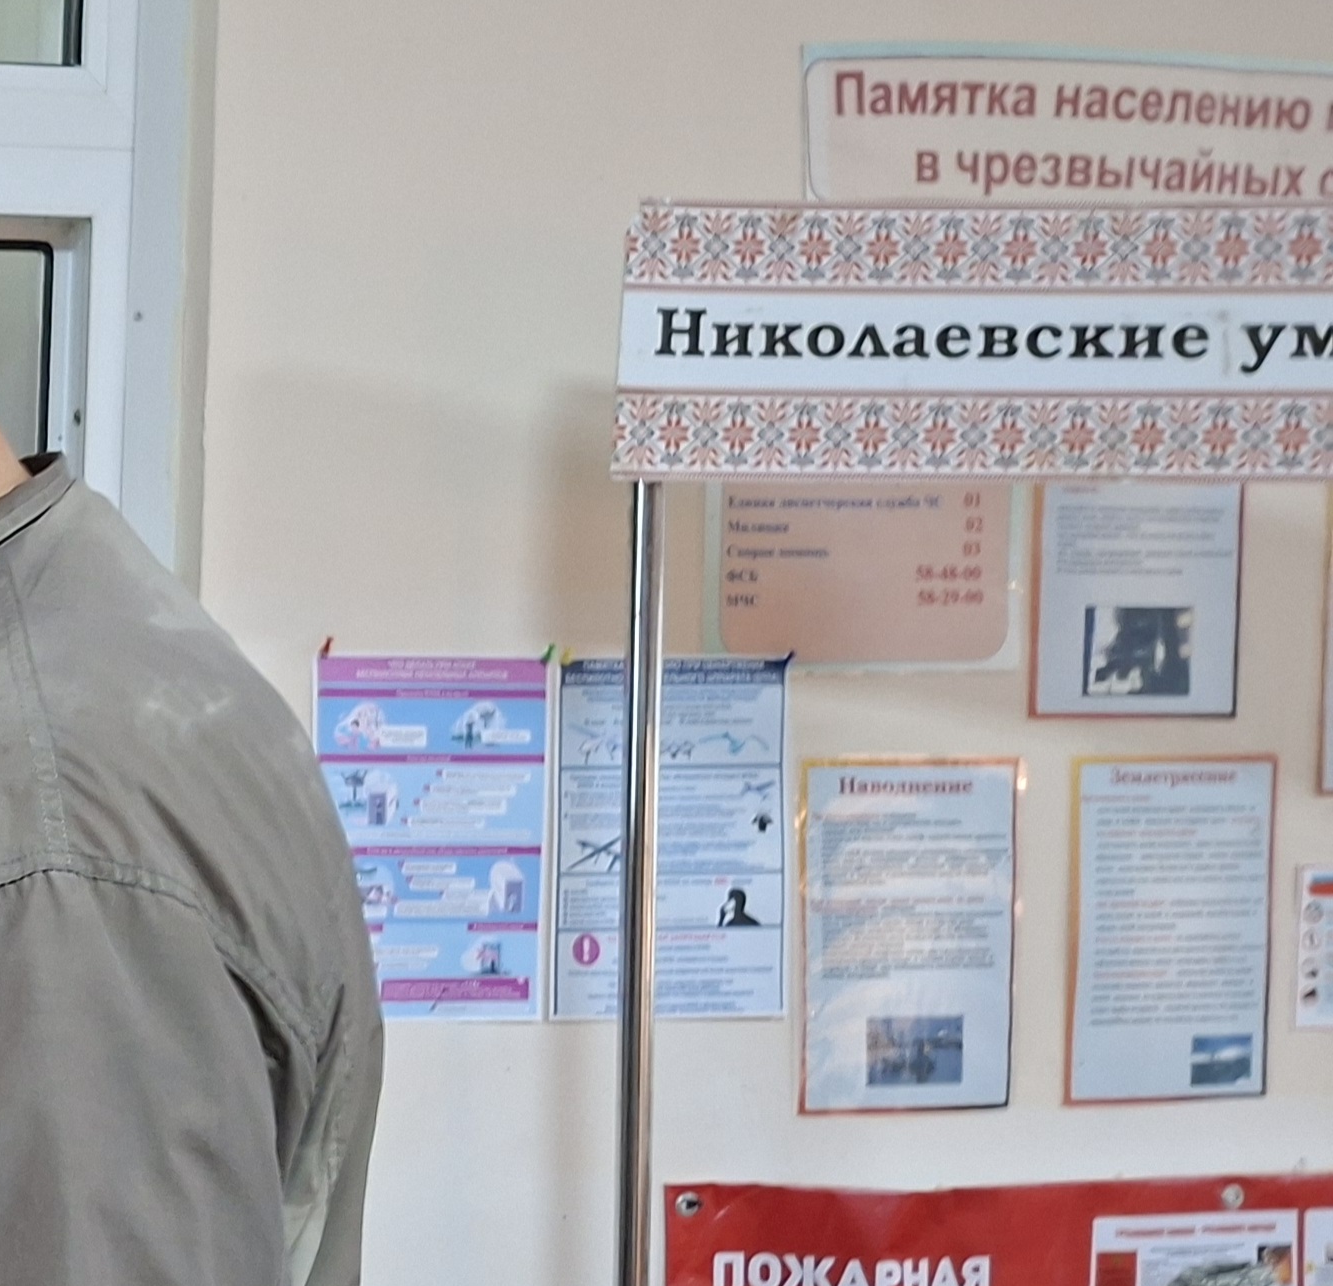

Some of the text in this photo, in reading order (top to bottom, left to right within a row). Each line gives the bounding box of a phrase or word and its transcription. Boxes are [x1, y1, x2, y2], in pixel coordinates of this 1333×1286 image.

[834, 70, 1036, 118] Памятка
[1053, 80, 1311, 132] населению
[916, 150, 938, 183] в
[955, 148, 1305, 197] чрезвычайных
[654, 308, 1210, 360] Николаевские
[965, 517, 983, 532] 02
